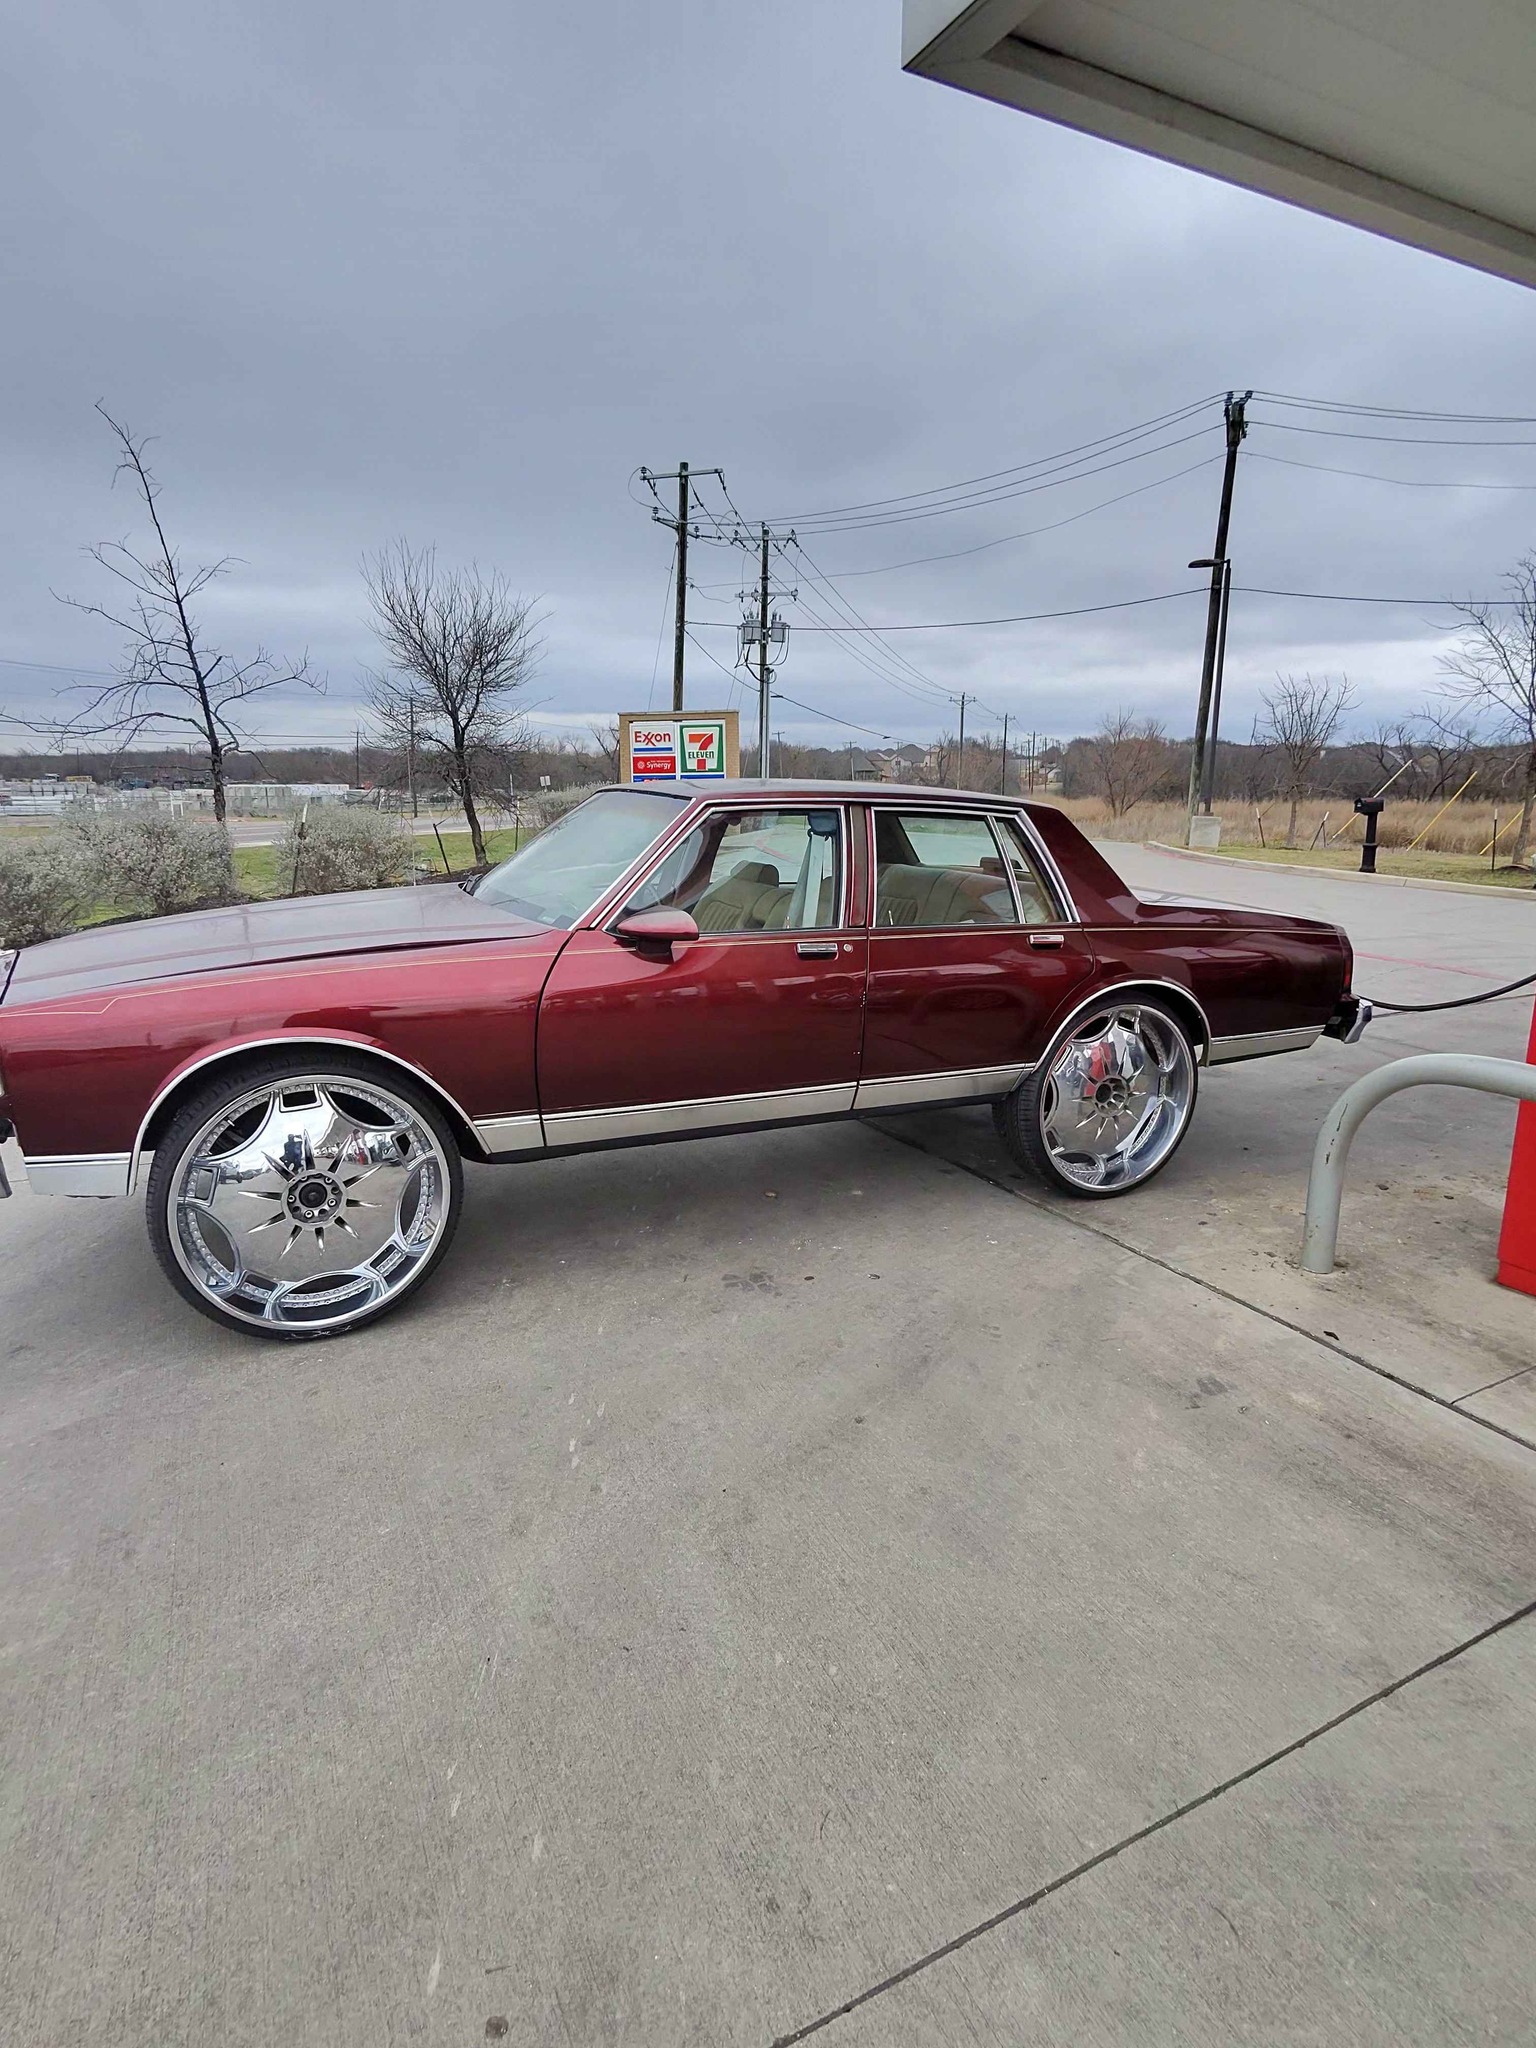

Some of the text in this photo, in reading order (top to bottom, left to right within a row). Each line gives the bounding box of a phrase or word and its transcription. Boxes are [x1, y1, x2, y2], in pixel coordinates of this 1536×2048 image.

[634, 731, 671, 747] Exxon
[688, 732, 714, 771] 7
[646, 761, 671, 770] Synergy
